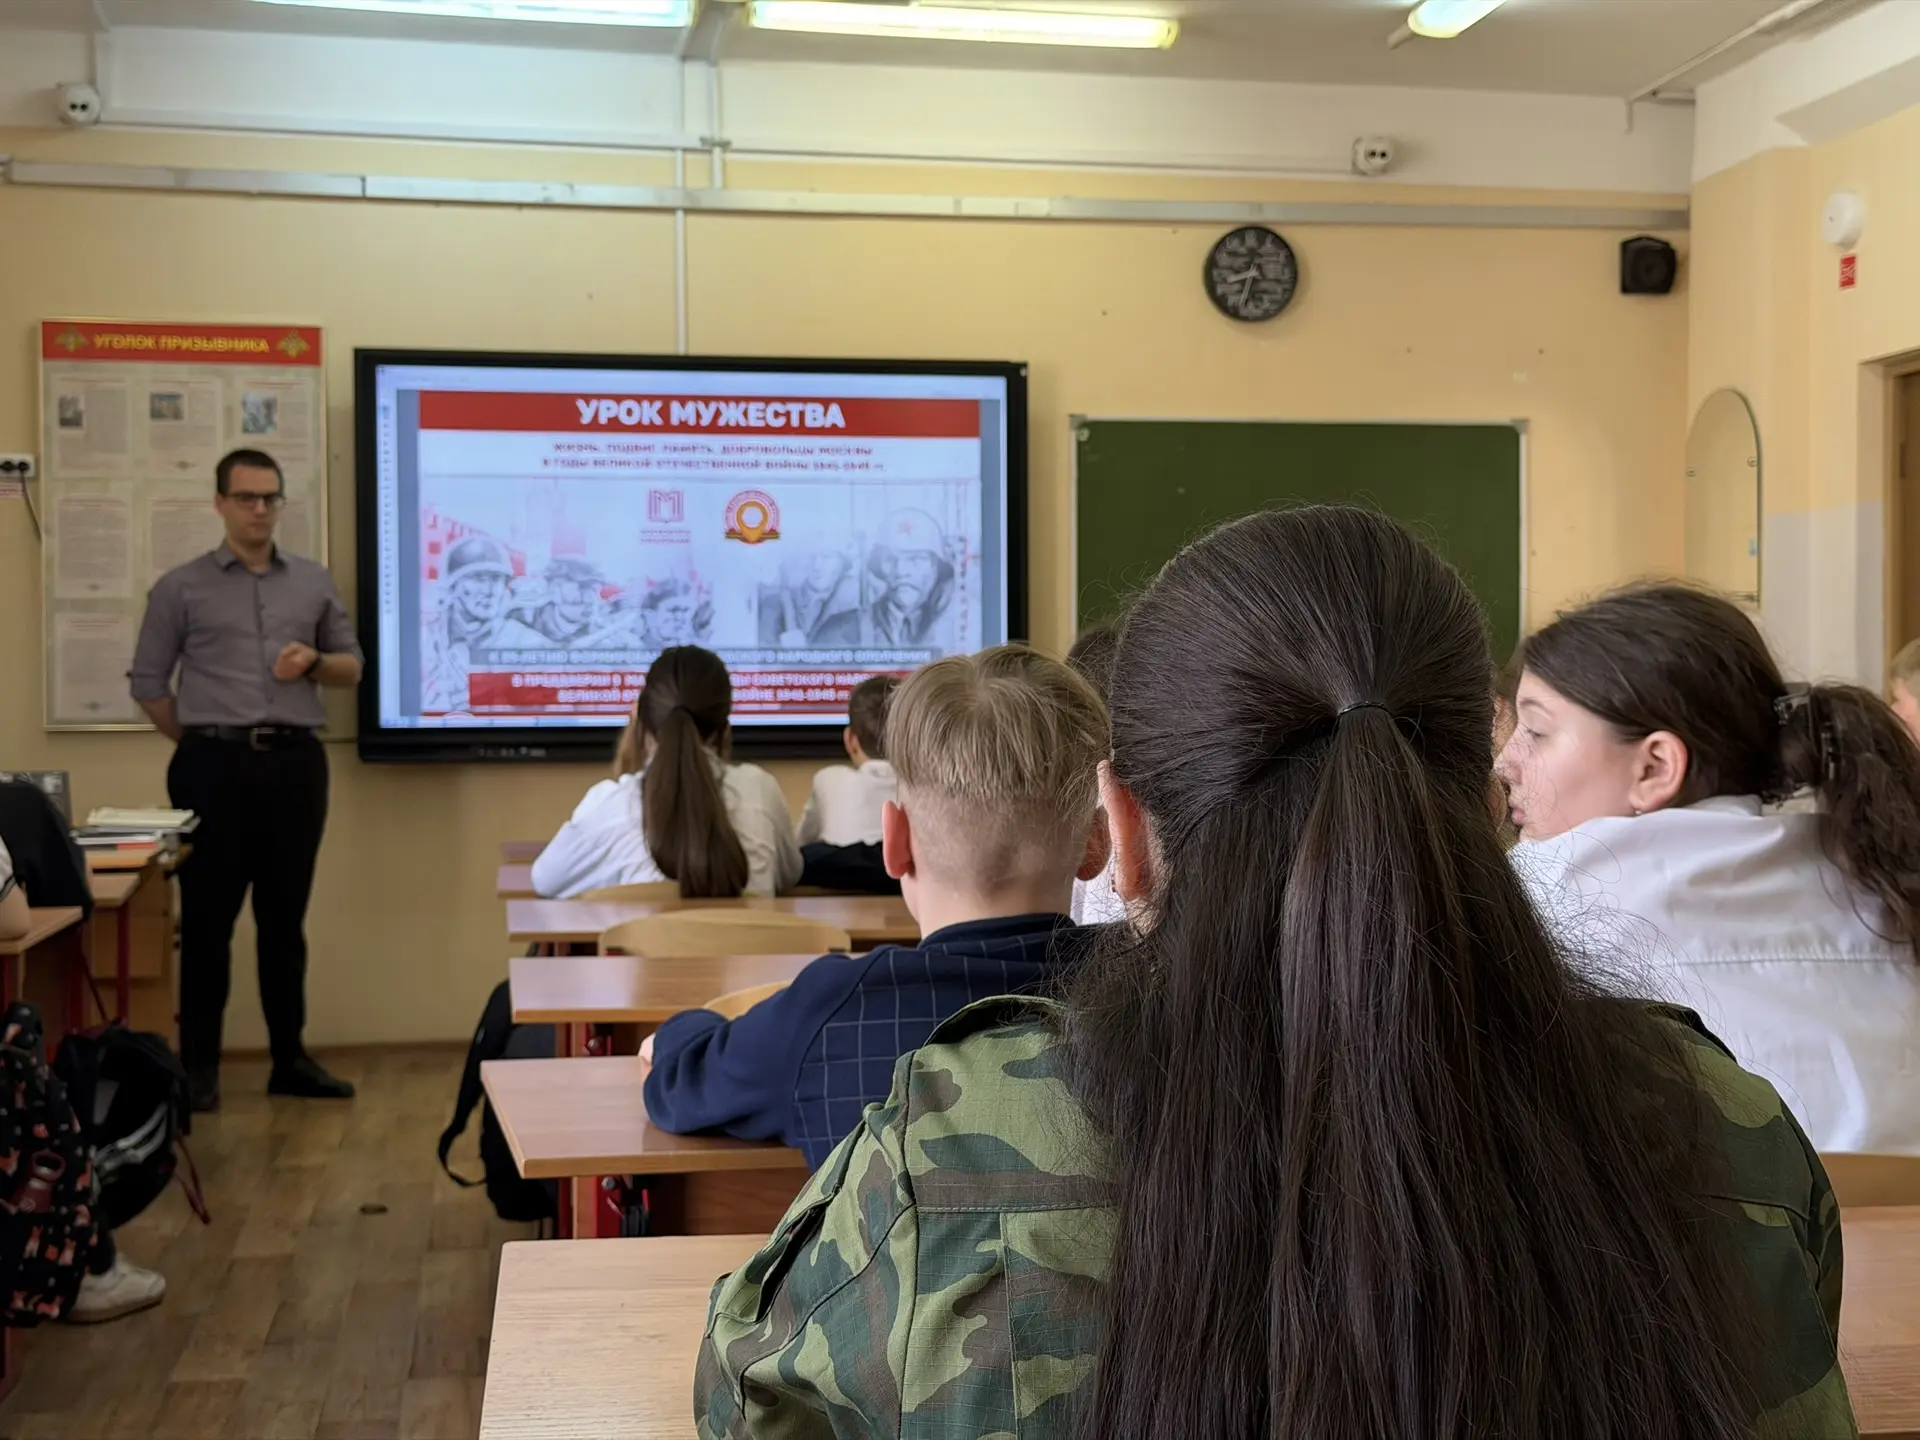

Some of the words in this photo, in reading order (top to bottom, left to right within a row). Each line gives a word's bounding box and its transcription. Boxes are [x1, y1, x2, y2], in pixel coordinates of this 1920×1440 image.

[94, 333, 156, 349] УГОЛОК
[158, 335, 270, 353] ПРИЗЫВНИКА
[575, 398, 665, 426] УРОК
[669, 400, 846, 429] МУЖЕСТВА
